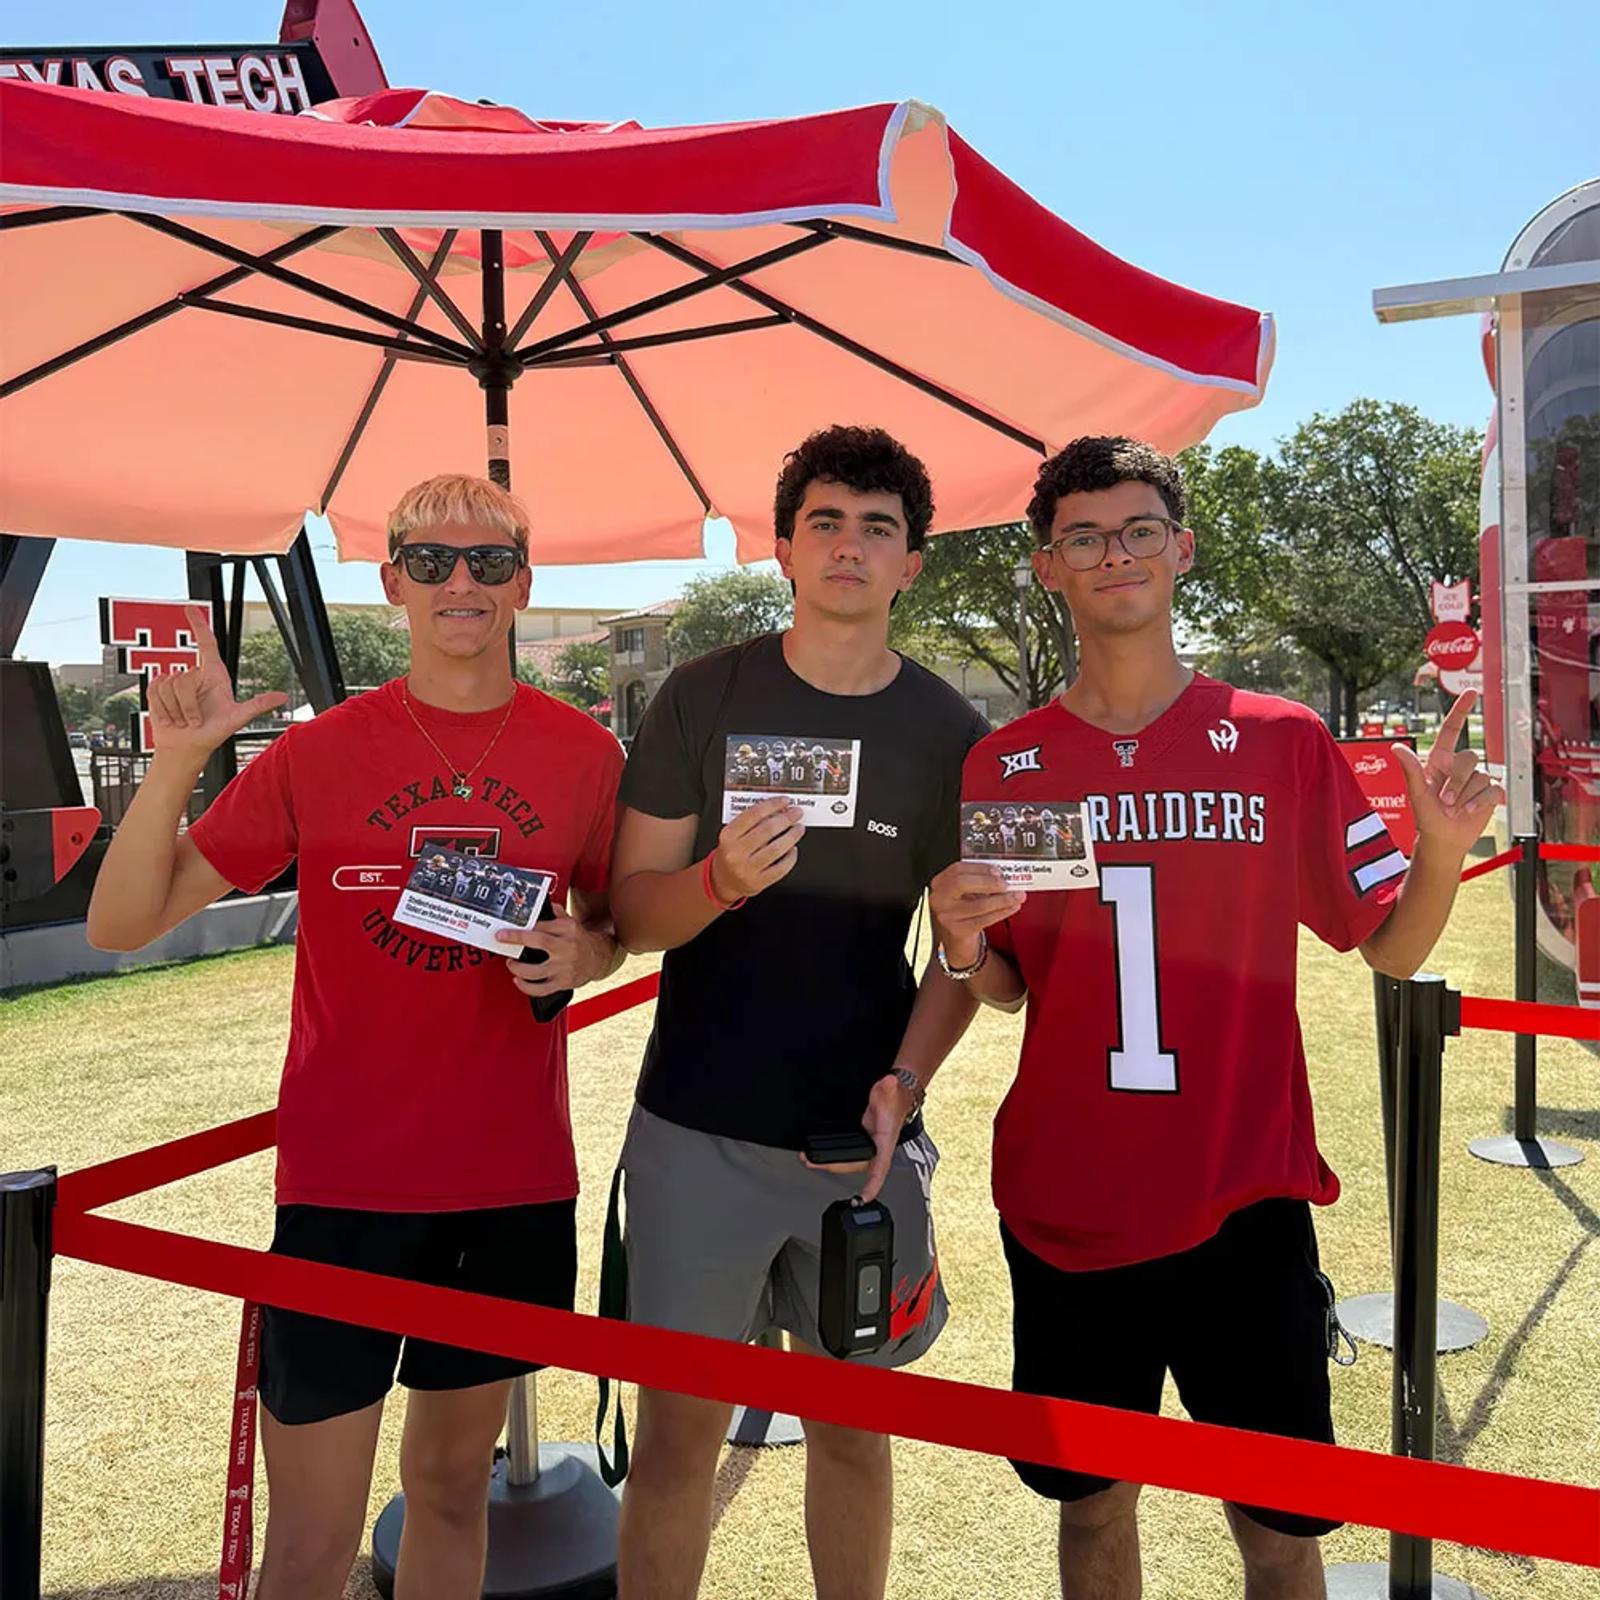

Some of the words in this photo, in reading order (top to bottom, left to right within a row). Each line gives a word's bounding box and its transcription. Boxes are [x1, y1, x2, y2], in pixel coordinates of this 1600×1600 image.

[0, 55, 150, 97] XAS
[165, 53, 312, 116] TECH
[1428, 637, 1475, 655] Coca-Cola
[790, 766, 804, 781] 10
[481, 776, 545, 839] TECH
[1366, 793, 1407, 808] ome!
[866, 820, 899, 838] BOSS
[1086, 790, 1266, 844] RAIDERS
[1022, 831, 1036, 847] 10
[359, 872, 385, 884] EST.
[473, 884, 490, 900] 10
[362, 908, 494, 972] UNIVERS
[1100, 863, 1180, 1094] 1
[247, 1306, 259, 1340] TEXAS
[245, 1341, 256, 1367] TECH
[238, 1406, 250, 1438] TEXAS
[236, 1440, 247, 1466] TECH
[230, 1504, 241, 1536] TEXAS
